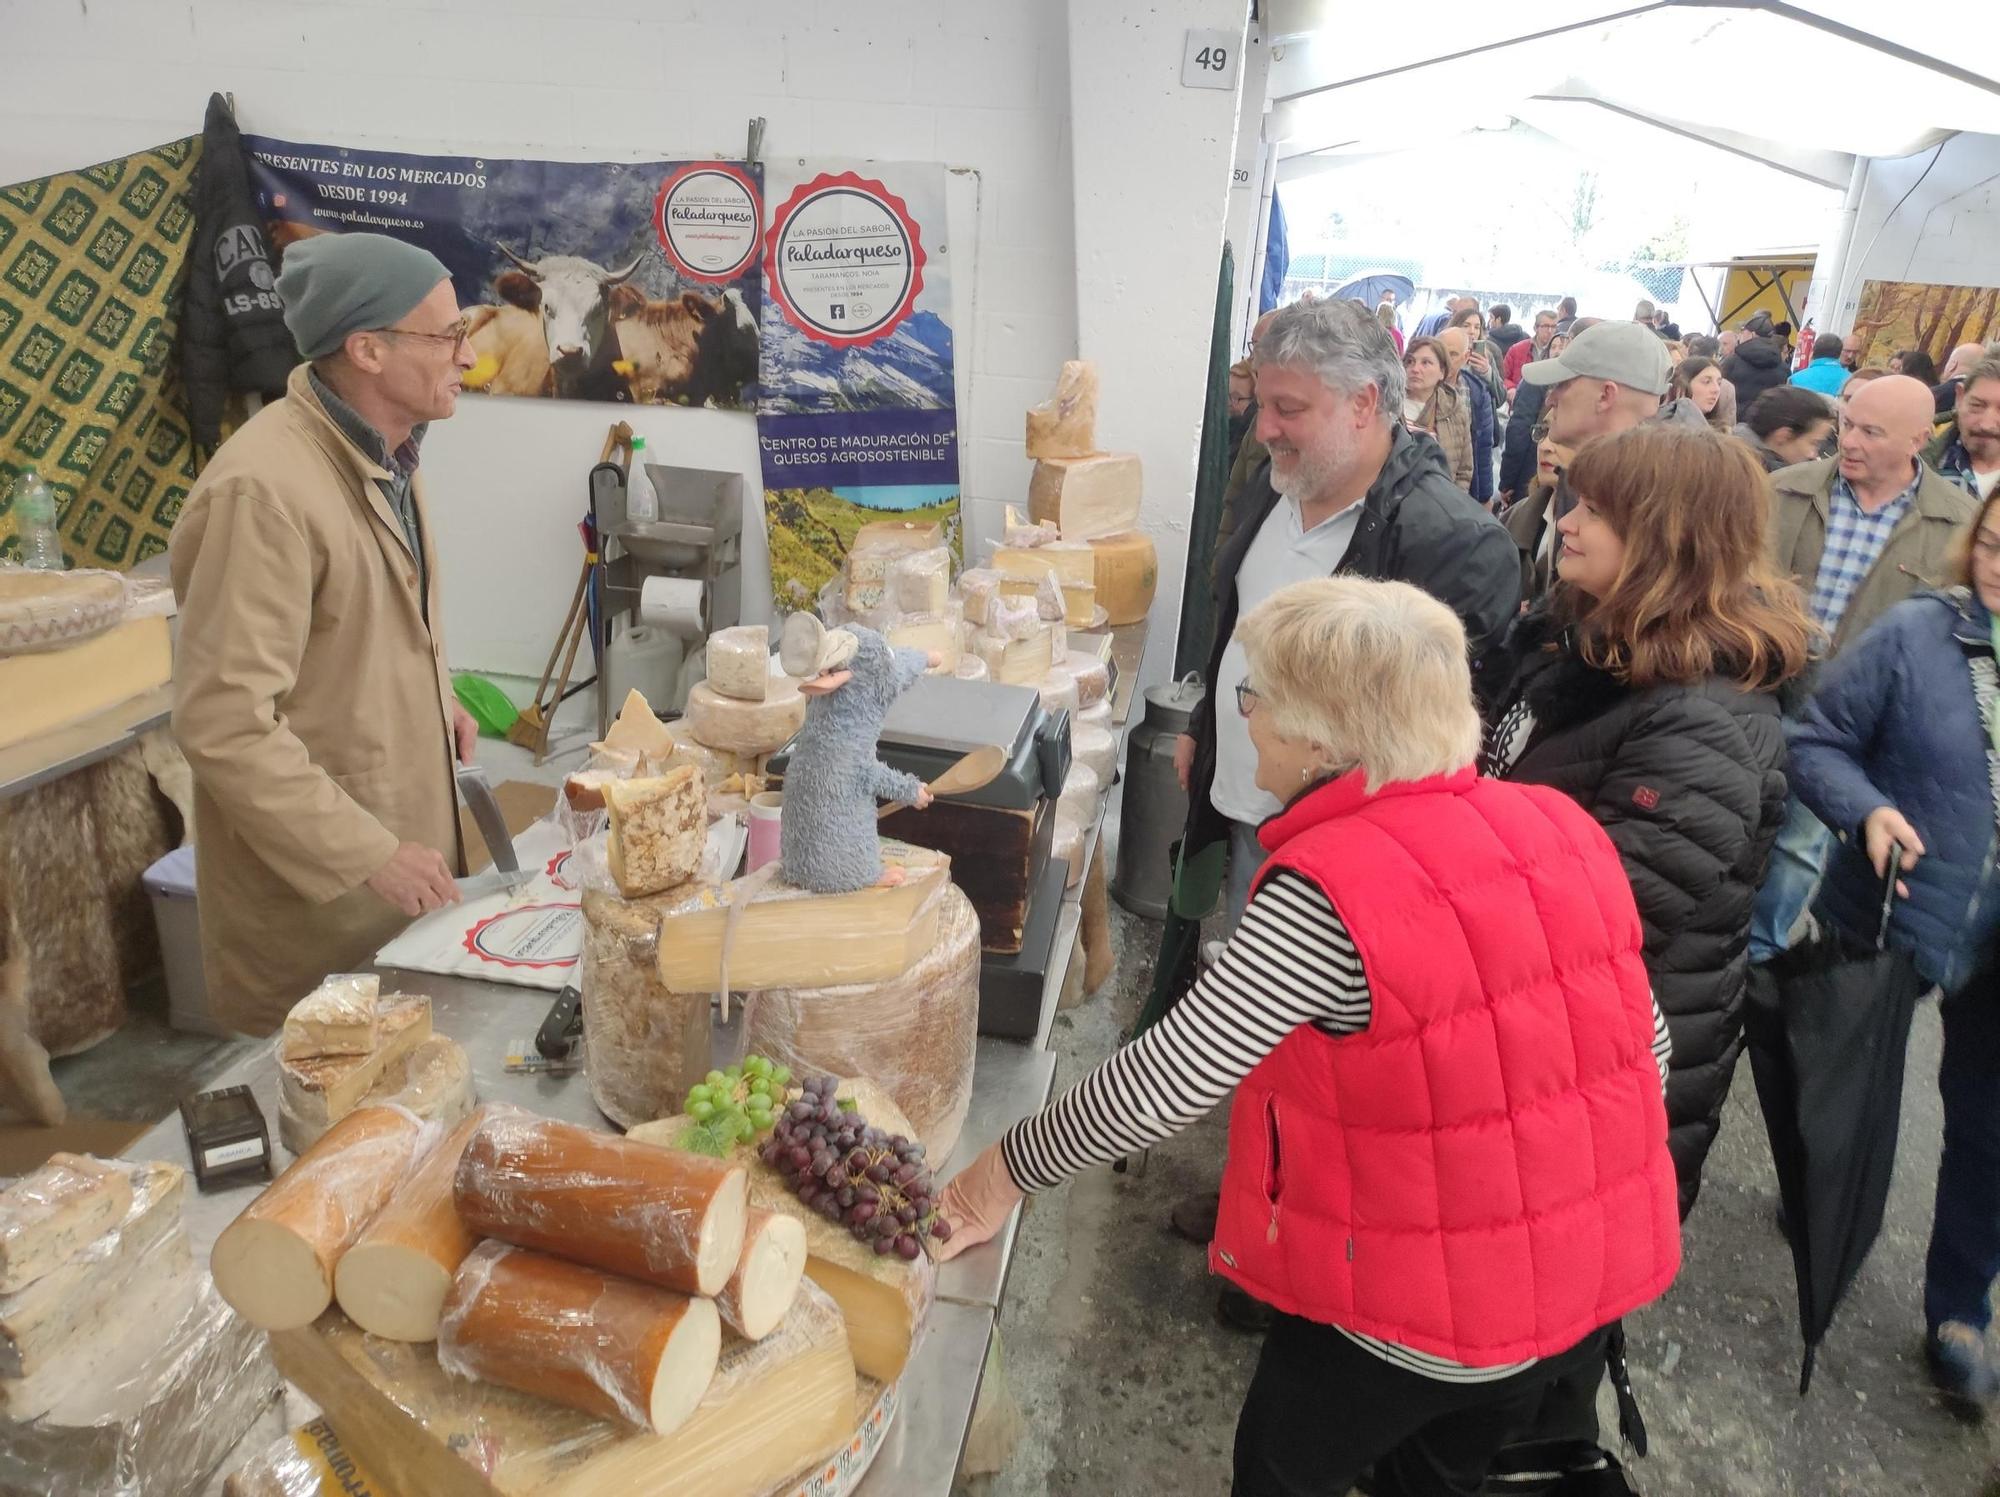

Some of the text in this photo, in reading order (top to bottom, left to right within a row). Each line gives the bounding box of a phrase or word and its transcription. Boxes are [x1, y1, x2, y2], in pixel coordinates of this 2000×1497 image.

[1195, 46, 1227, 71] 49
[342, 162, 365, 178] EN
[367, 167, 397, 181] LOS
[399, 168, 488, 189] MERCADOS
[1232, 169, 1249, 182] 50
[317, 183, 409, 206] DESDE 1994
[313, 207, 425, 230] www.paladarqueso.es
[671, 206, 752, 225] Paladarqueso
[793, 228, 804, 238] LA
[840, 226, 859, 235] DEL
[860, 223, 891, 234] SABOR
[787, 242, 902, 264] Paladarqueso
[861, 269, 880, 277] NOIA
[763, 432, 951, 450] CENTRO DE MADURACIÓN DE
[773, 448, 946, 465] QUESOS AGROSOSTENIBLE
